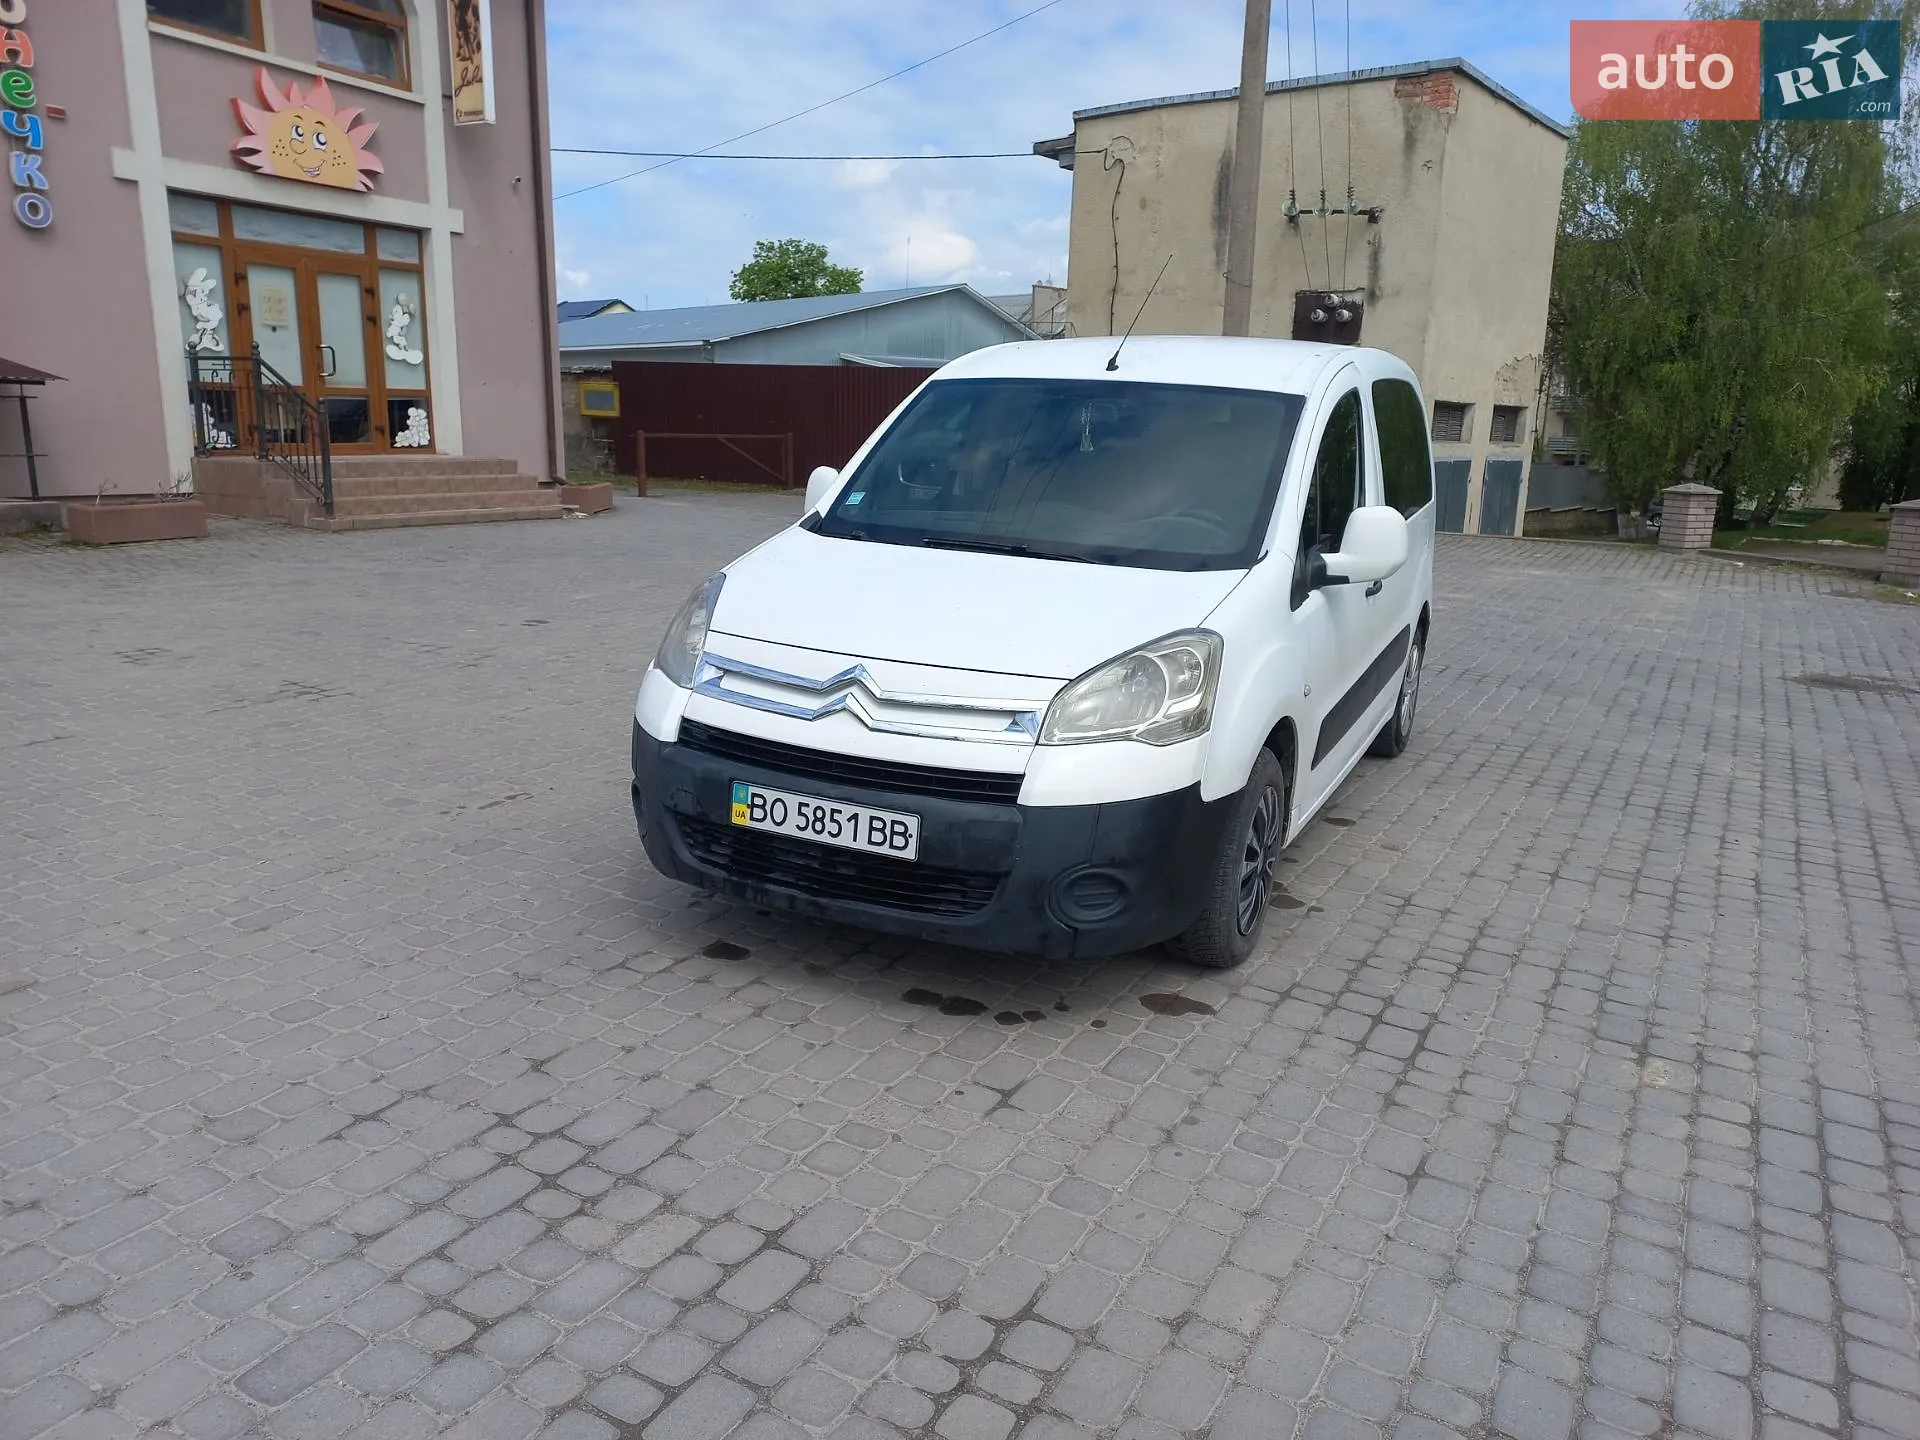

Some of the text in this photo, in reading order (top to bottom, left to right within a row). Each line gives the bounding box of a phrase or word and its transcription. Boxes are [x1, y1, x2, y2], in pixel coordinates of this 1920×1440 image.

[734, 809, 746, 820] UA
[750, 792, 910, 852] BO 5851 BB
